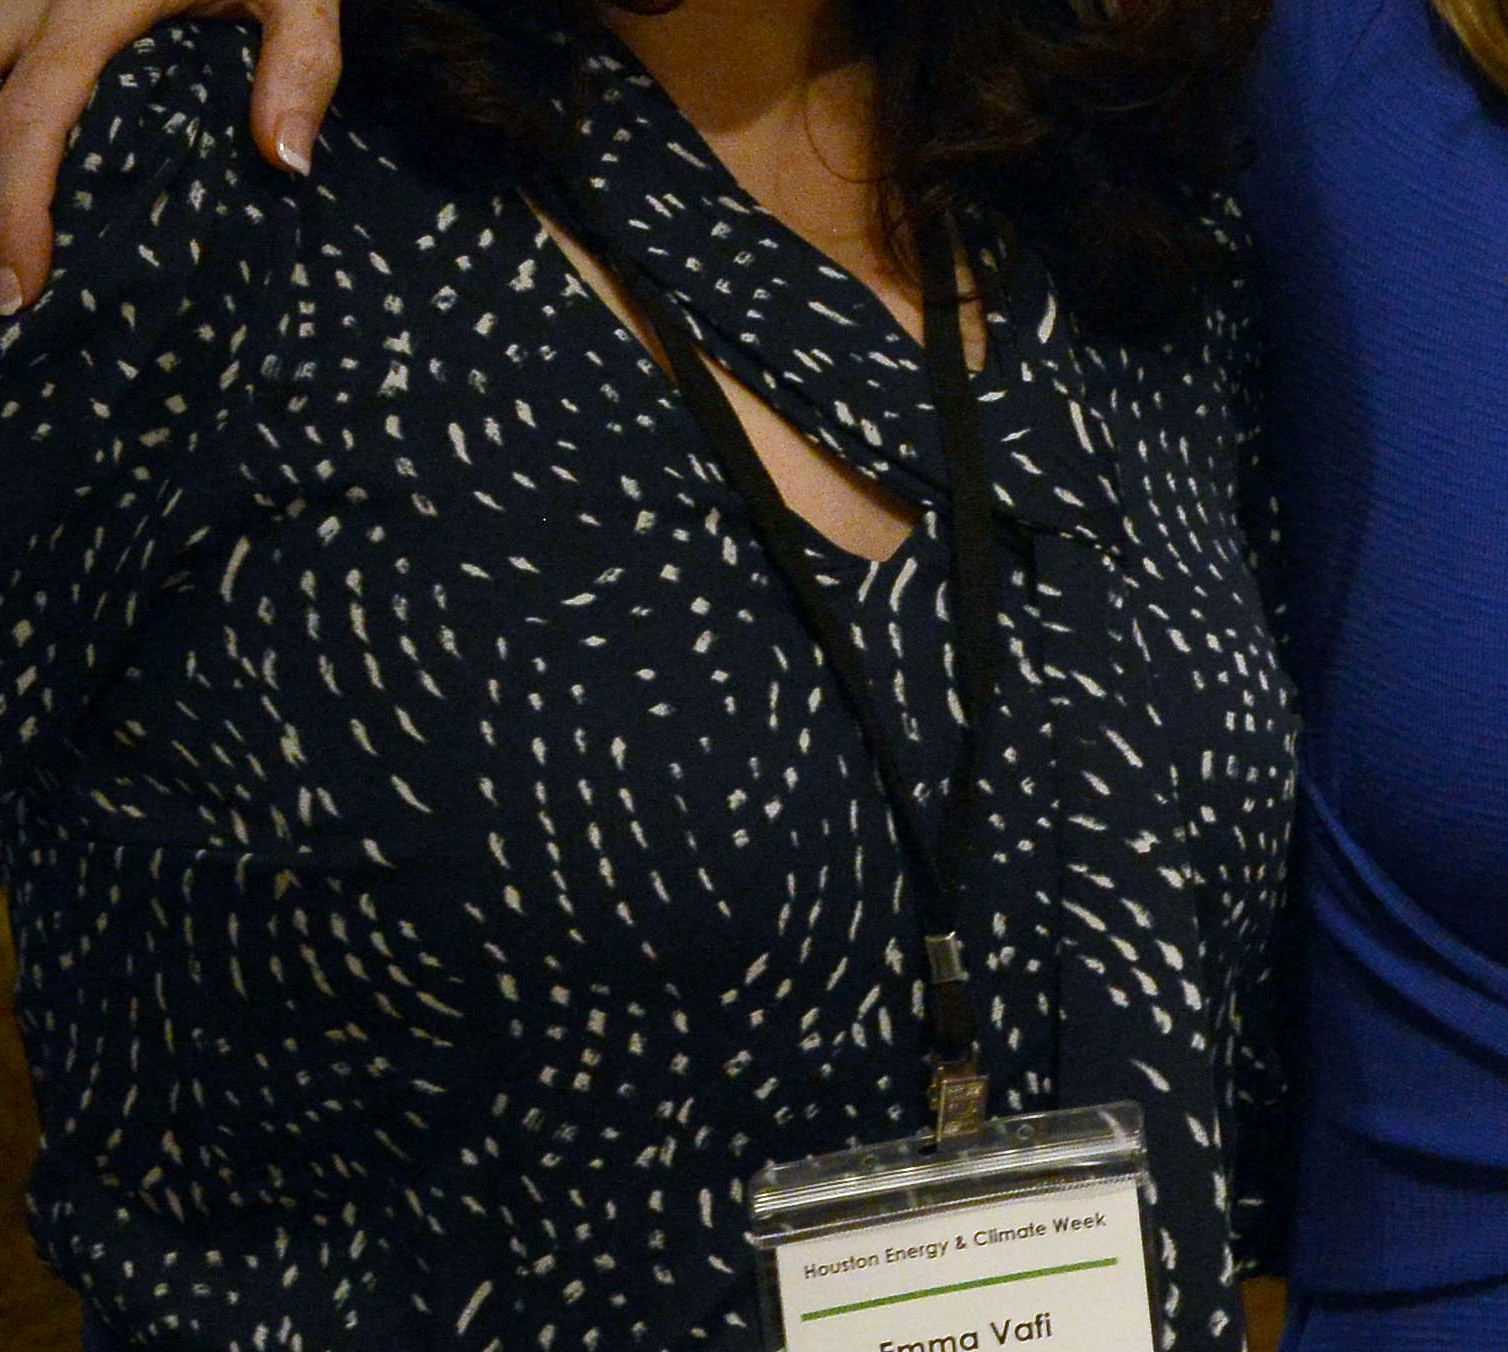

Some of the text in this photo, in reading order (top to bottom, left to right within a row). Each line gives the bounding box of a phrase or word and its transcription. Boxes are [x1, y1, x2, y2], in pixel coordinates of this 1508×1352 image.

[803, 1211, 1107, 1280] Houston Energy & Climate Week
[990, 1311, 1054, 1346] Vafi
